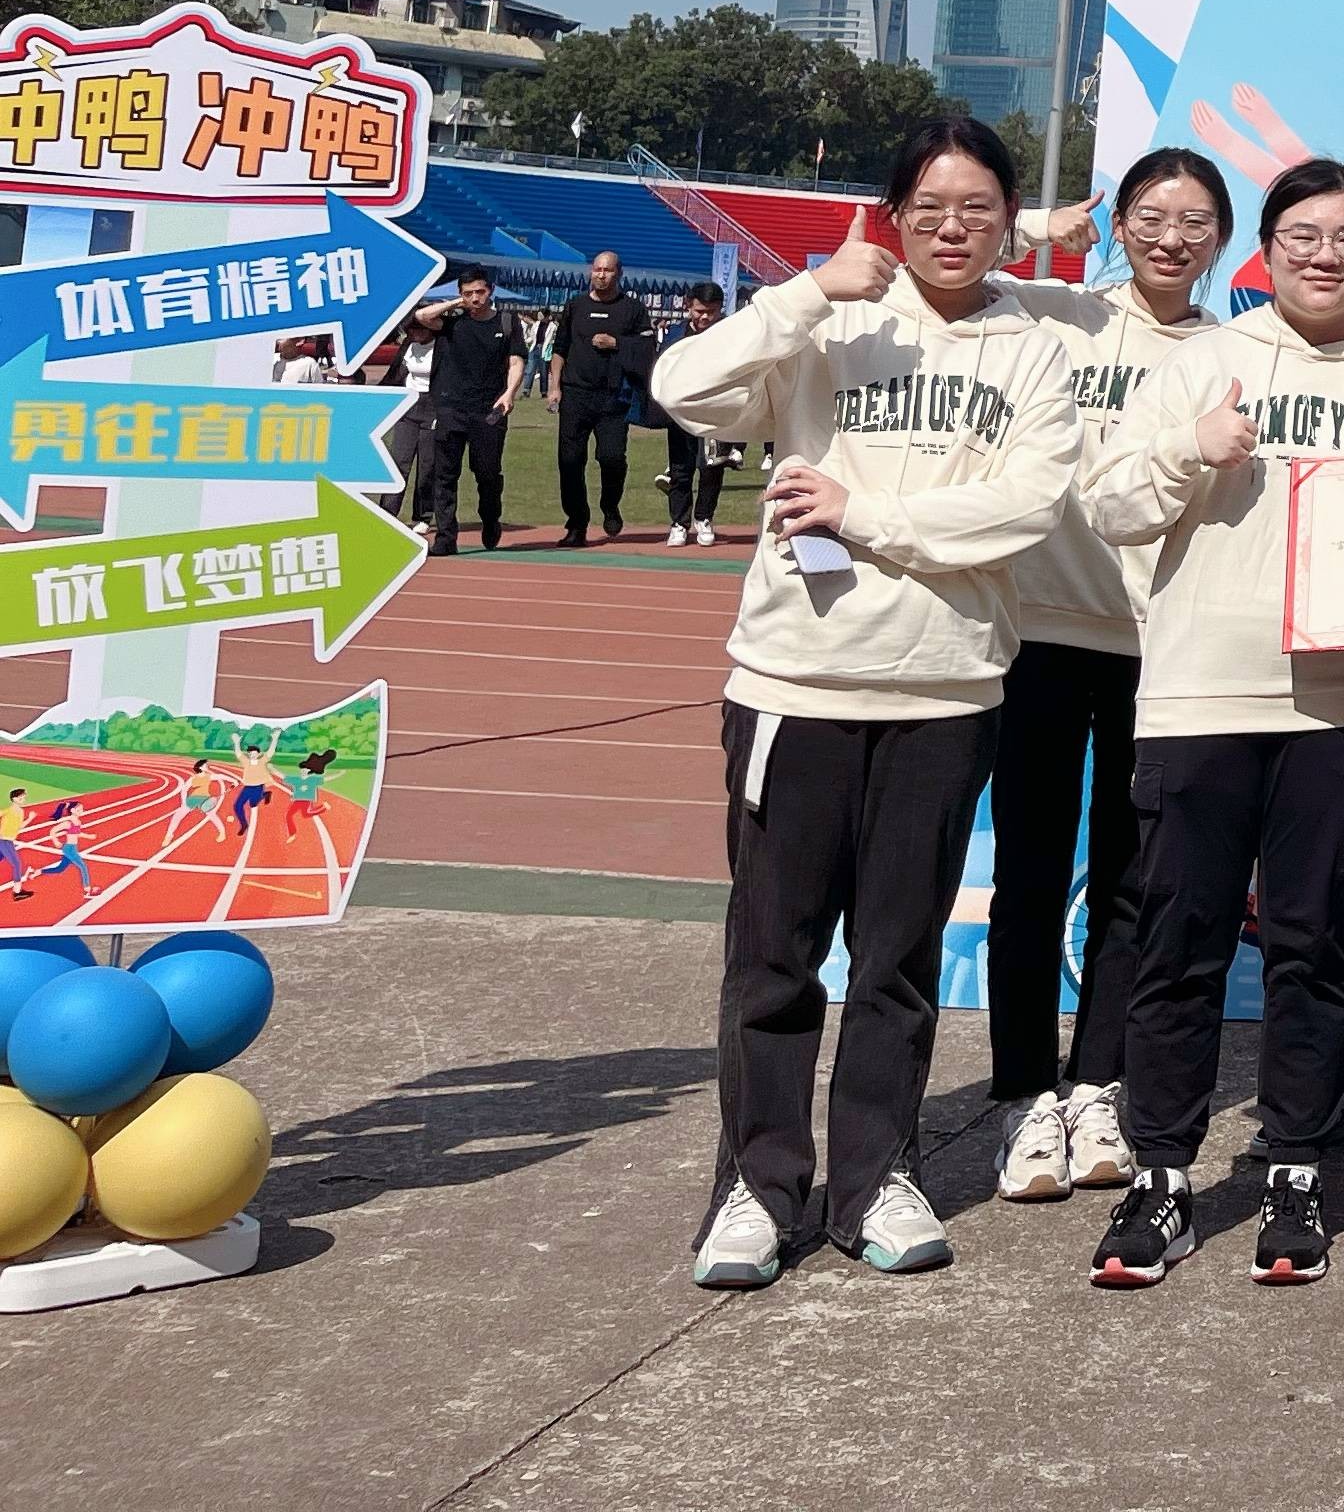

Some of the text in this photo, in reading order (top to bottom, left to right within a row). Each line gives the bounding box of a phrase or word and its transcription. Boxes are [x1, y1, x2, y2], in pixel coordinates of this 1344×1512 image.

[184, 72, 398, 182] 冲鸭
[55, 246, 370, 342] 体育精神
[928, 374, 965, 433] OF
[1291, 394, 1326, 447] OF
[32, 533, 342, 628] 放飞梦想
